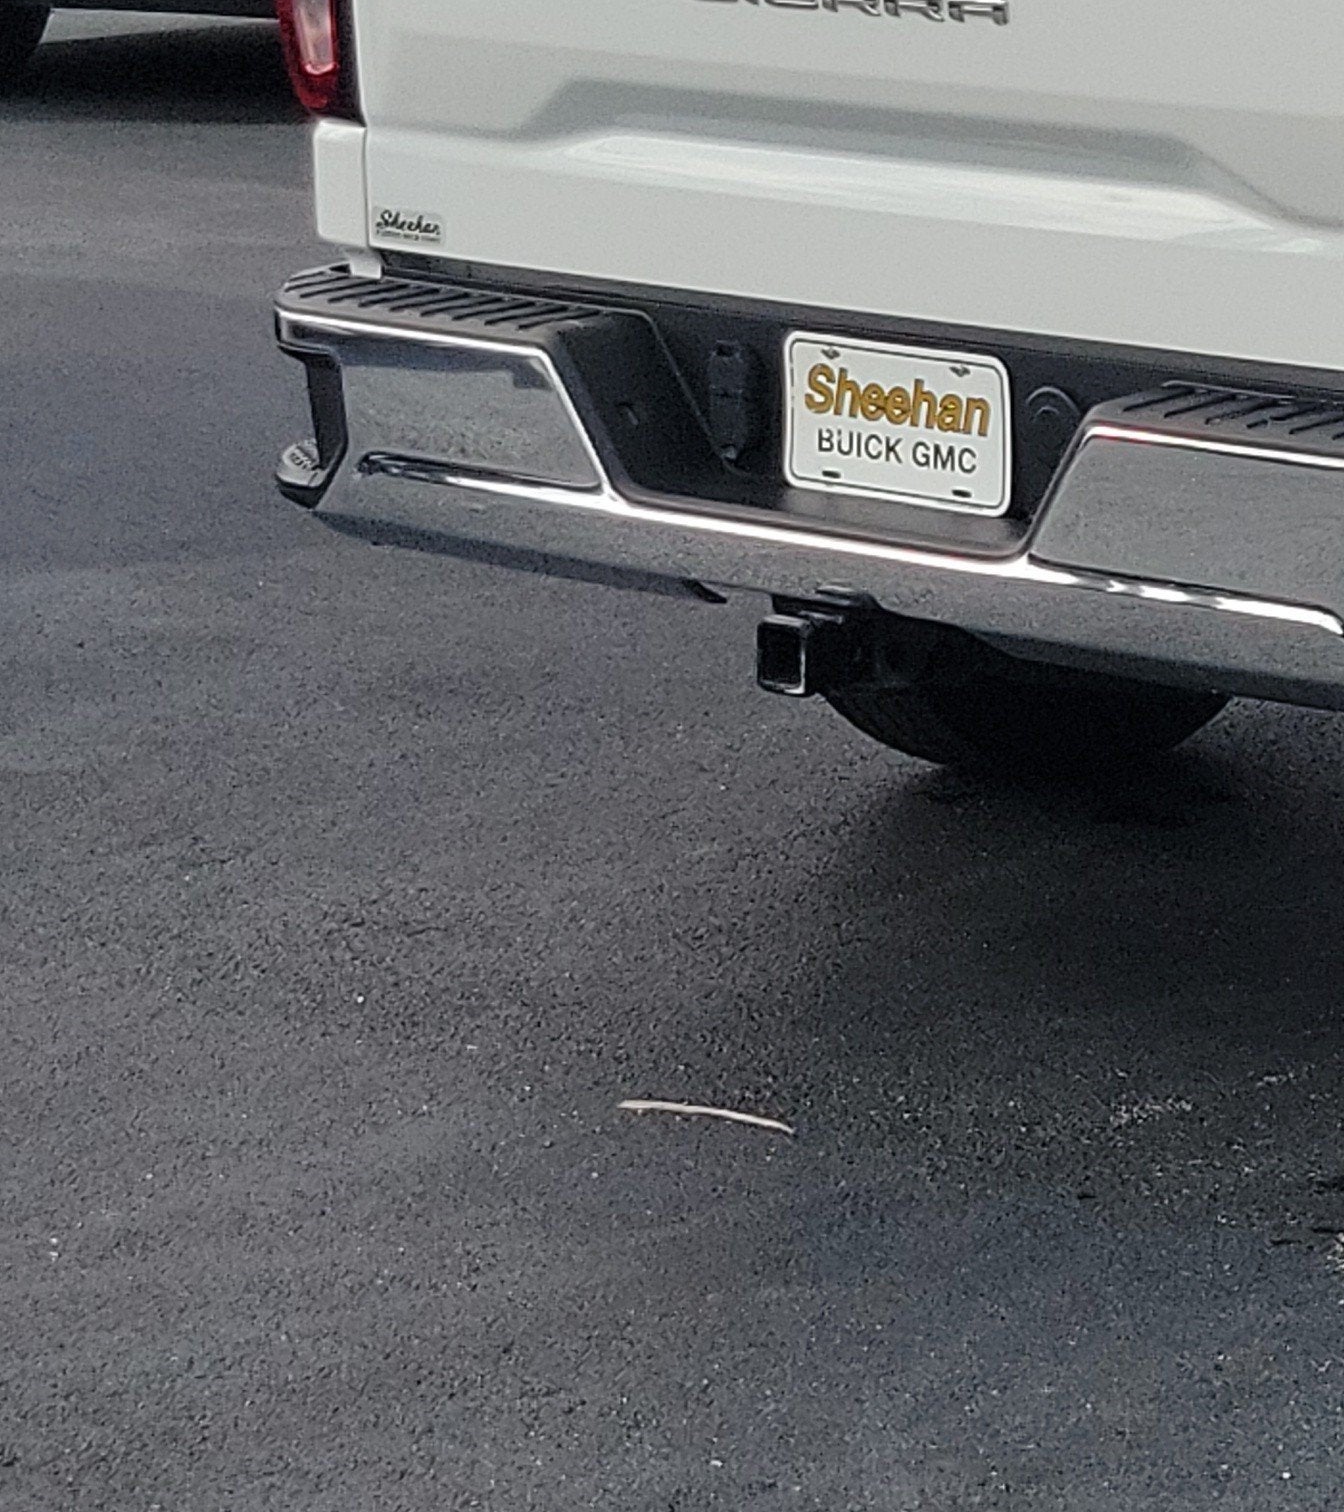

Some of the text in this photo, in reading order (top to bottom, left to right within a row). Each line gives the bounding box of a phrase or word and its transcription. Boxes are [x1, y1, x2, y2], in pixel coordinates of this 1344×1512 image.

[804, 363, 991, 437] Sheehan
[817, 428, 977, 474] BUICK GMC
